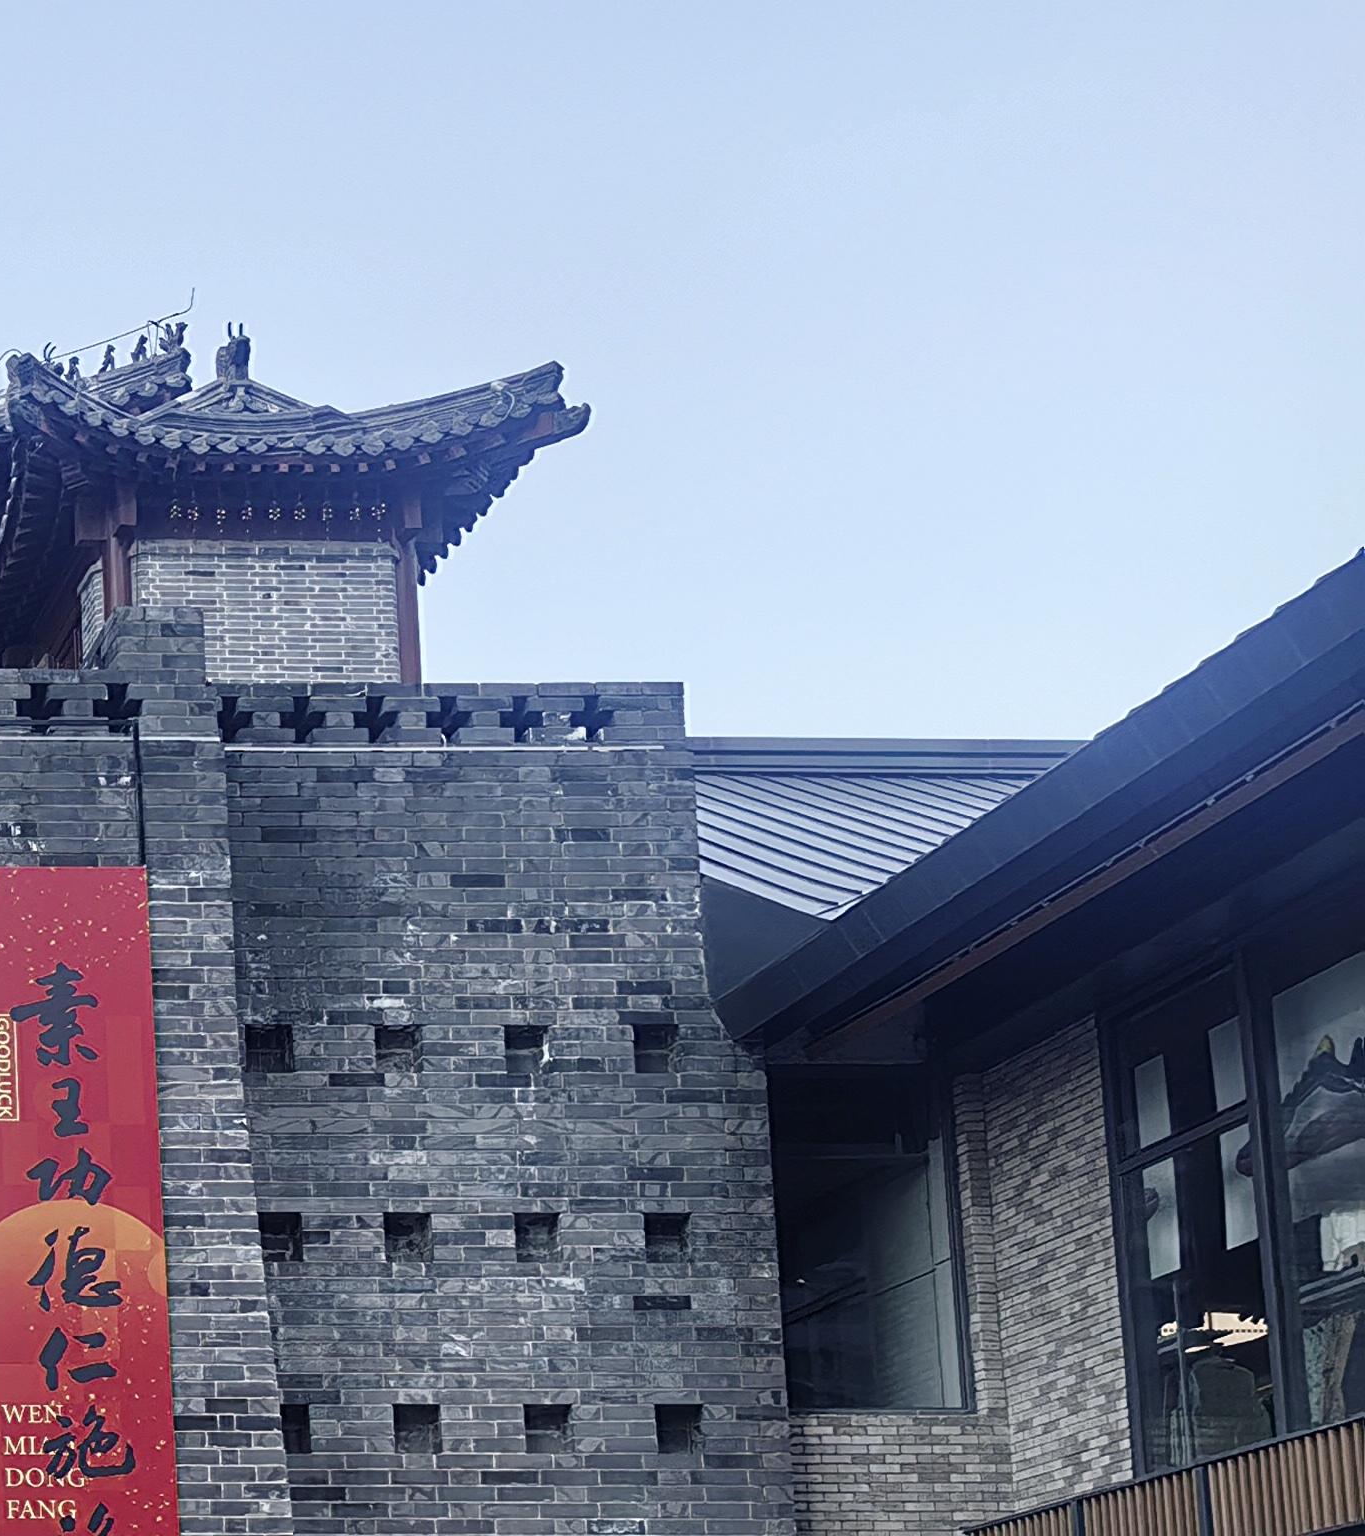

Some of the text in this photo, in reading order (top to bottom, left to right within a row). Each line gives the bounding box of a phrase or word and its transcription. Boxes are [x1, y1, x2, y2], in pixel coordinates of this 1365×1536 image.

[1, 1403, 64, 1424] WEN
[3, 1435, 73, 1457] MIA
[5, 1467, 85, 1488] DONG
[6, 1499, 77, 1520] FANG
